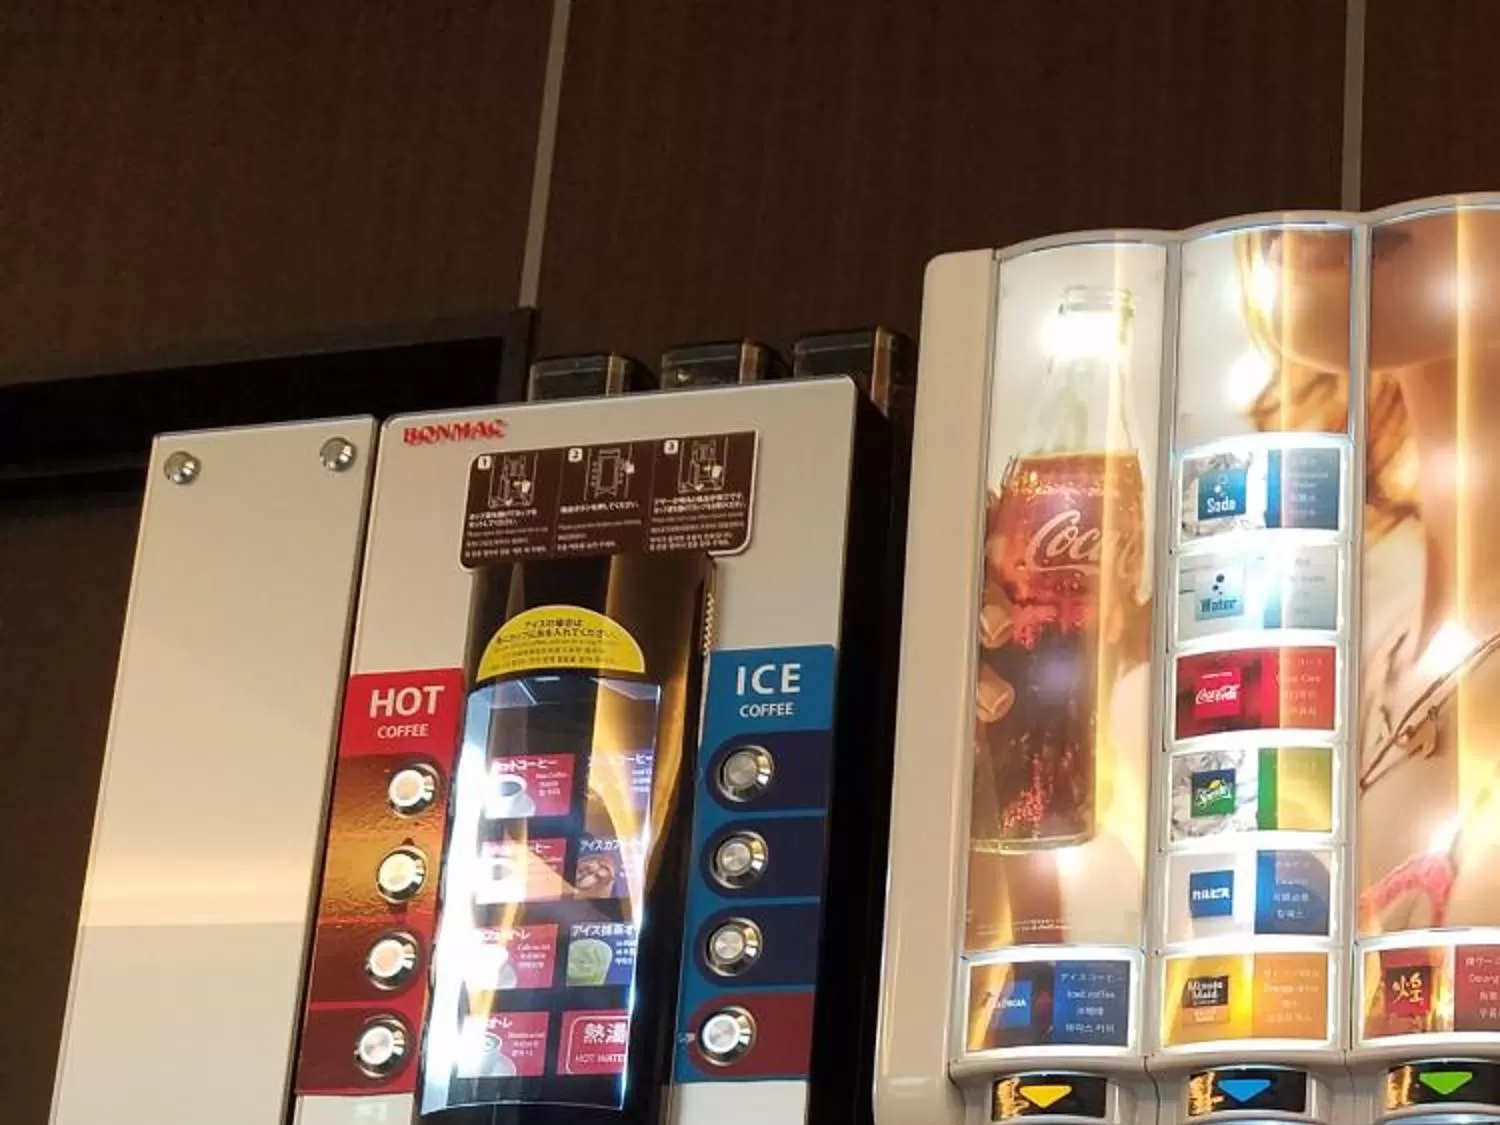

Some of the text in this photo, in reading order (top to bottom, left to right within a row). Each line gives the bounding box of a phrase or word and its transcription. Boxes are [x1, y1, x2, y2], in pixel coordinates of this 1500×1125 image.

[737, 663, 801, 695] ICE
[369, 685, 445, 718] HOT
[739, 702, 794, 718] COFFEE
[377, 723, 429, 739] COFFEE
[597, 1052, 626, 1063] WATE
